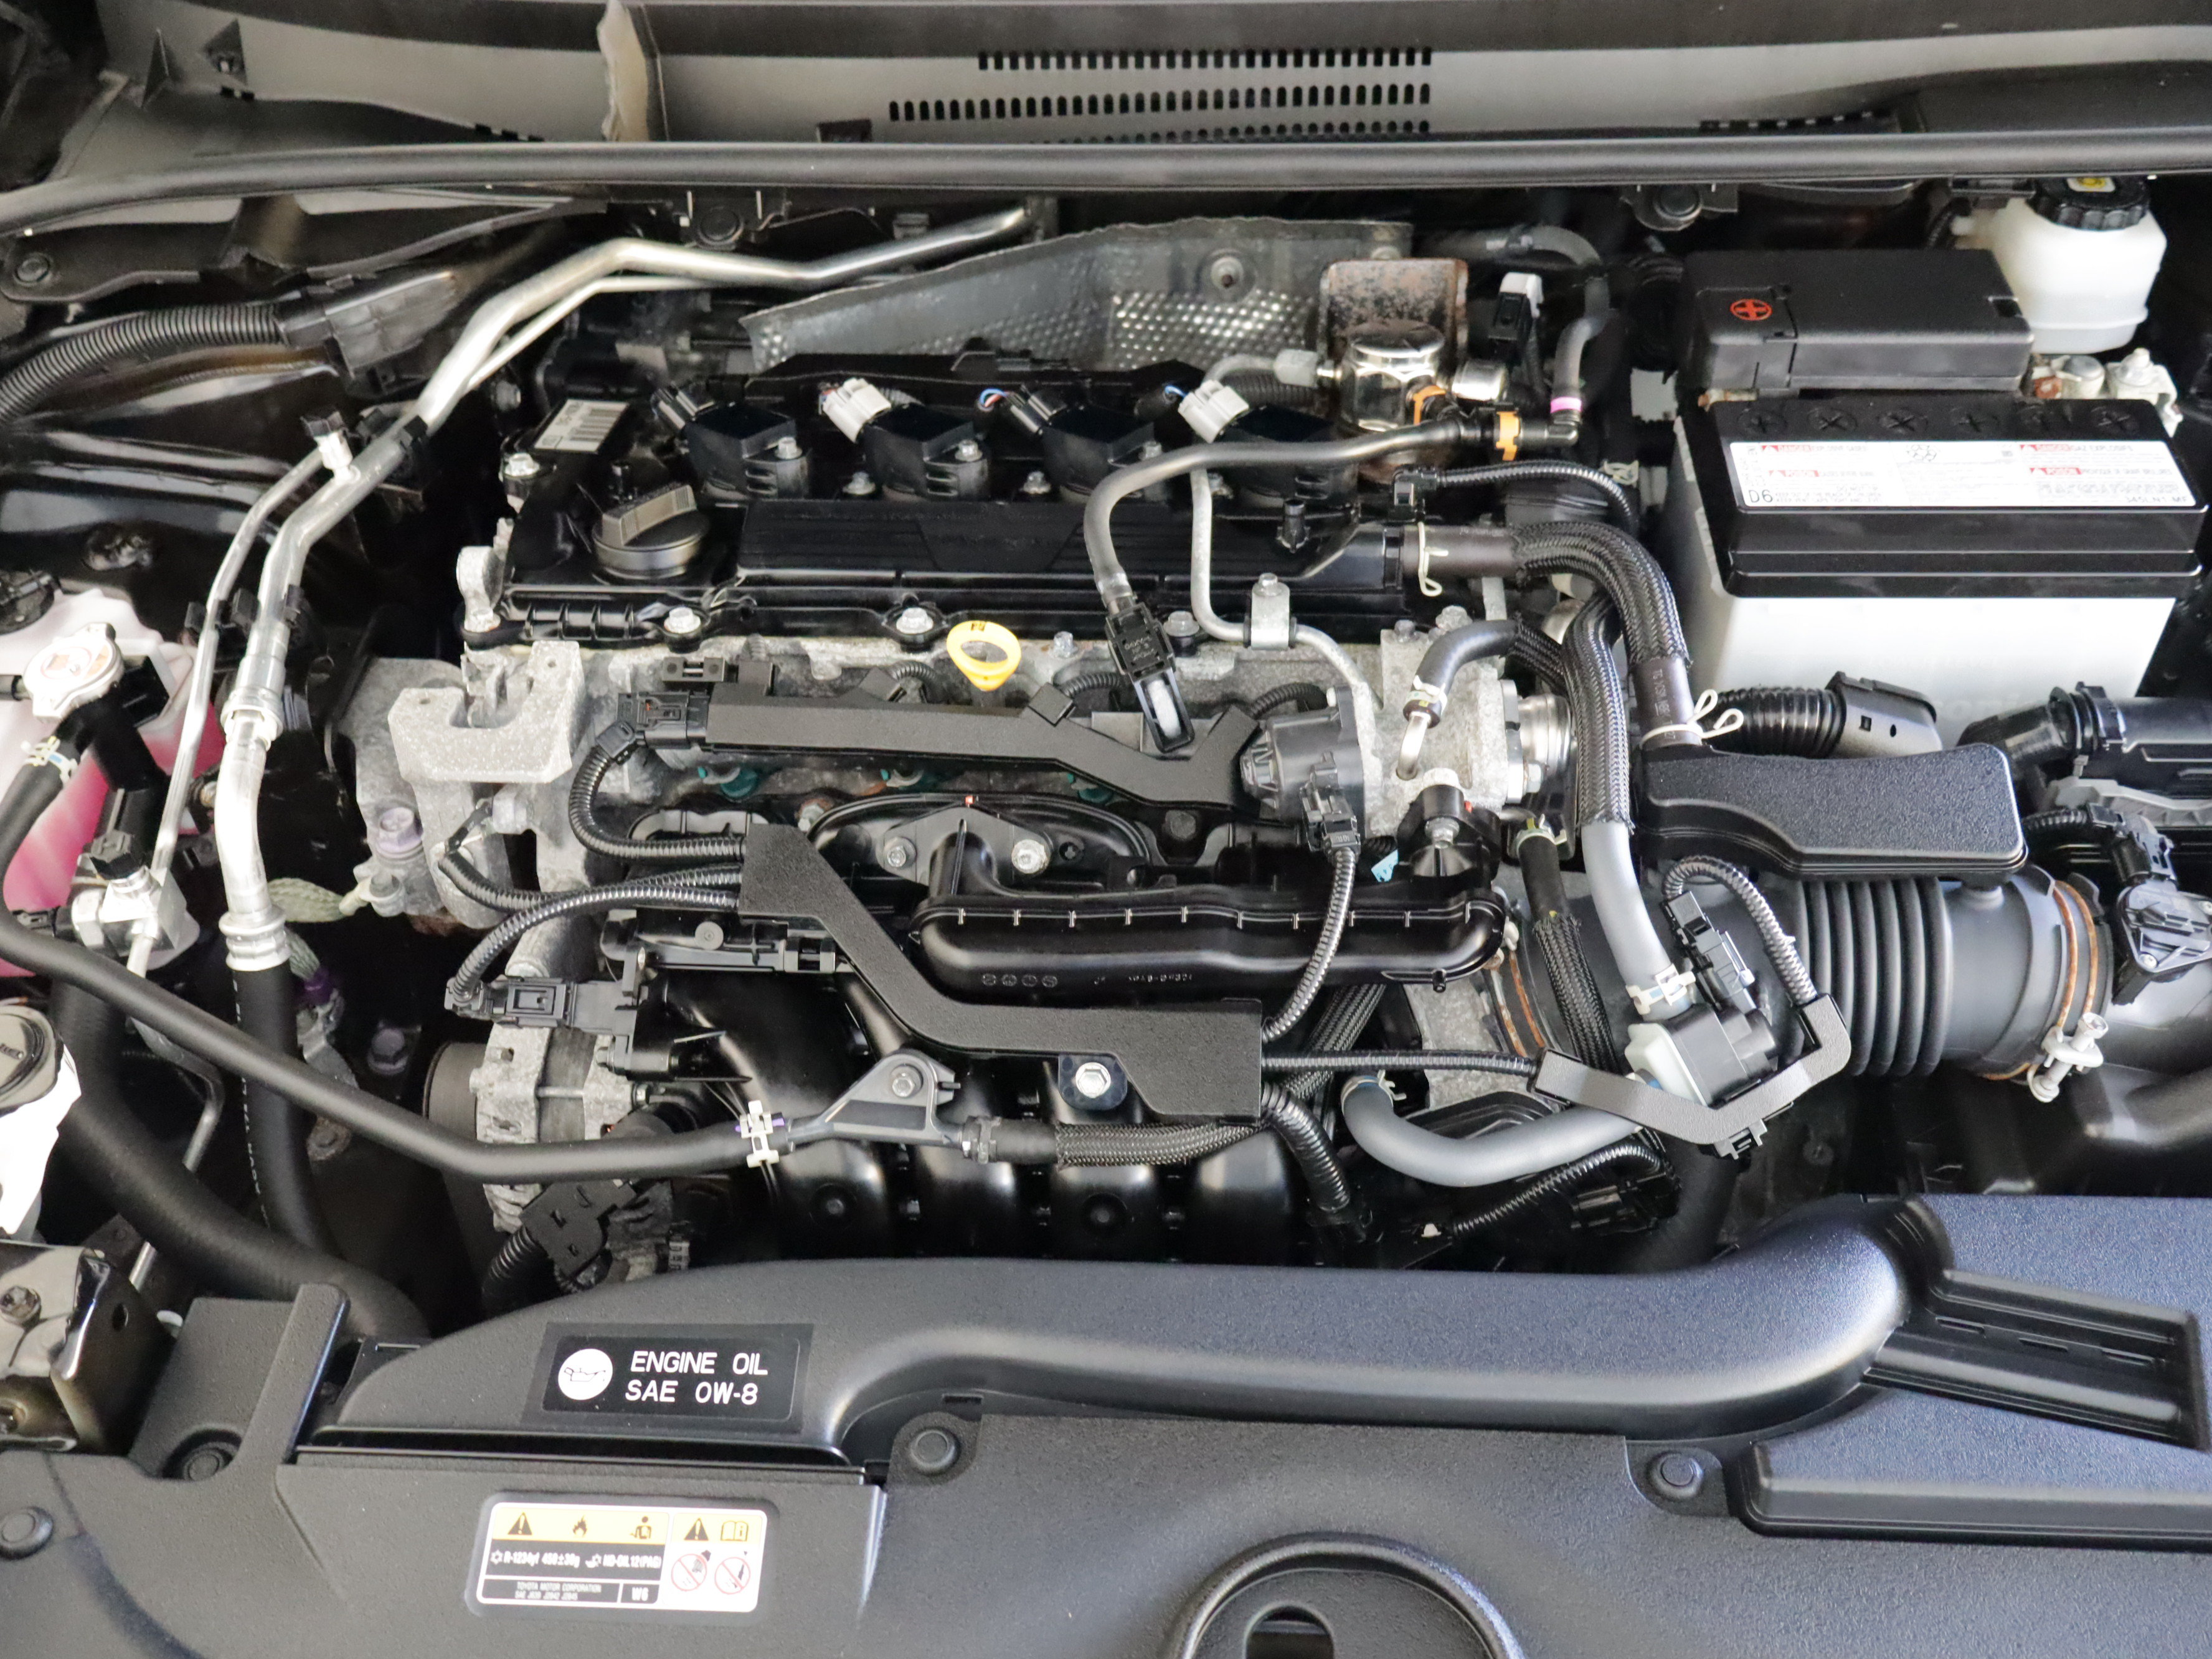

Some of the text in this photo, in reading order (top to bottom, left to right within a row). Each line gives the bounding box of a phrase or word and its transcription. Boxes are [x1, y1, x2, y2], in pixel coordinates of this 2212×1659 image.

[1749, 489, 1773, 503] D6
[631, 1350, 768, 1375] ENGINE OIL
[625, 1379, 759, 1405] SAE 0W-8
